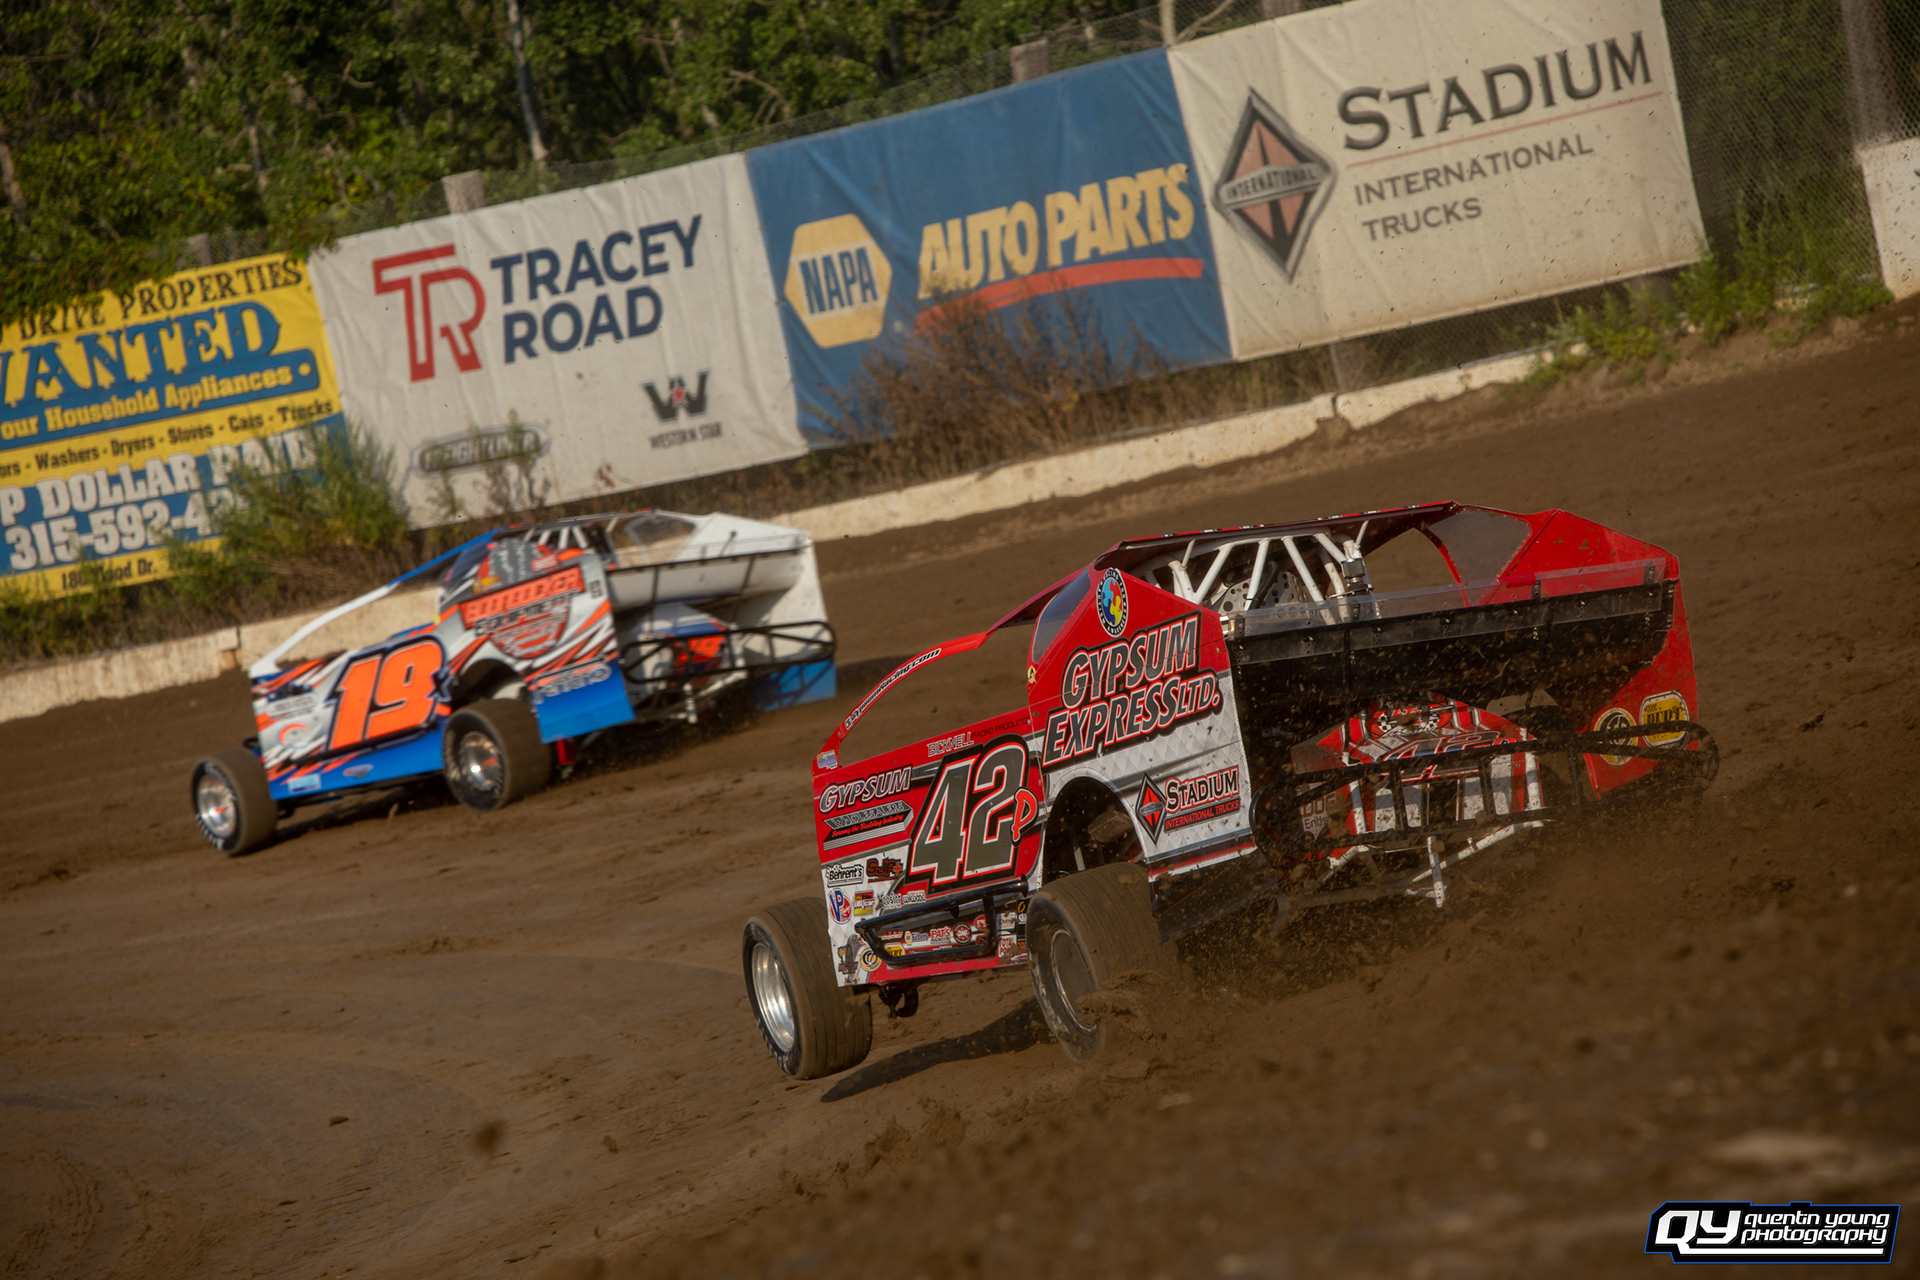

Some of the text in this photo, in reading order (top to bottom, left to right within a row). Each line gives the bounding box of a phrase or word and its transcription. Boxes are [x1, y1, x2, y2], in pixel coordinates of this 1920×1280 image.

[1337, 31, 1654, 151] STADIUM
[1226, 167, 1317, 199] INTERNATIONAL
[1353, 134, 1595, 207] INTERNATIONAL
[918, 163, 1196, 298] AUTO PARTS
[1362, 197, 1483, 243] TRUCKS
[490, 214, 702, 304] TRACEY
[799, 246, 879, 315] NAPA
[20, 258, 302, 341] DRIVE PROPERTIES
[502, 285, 664, 364] ROAD
[46, 387, 159, 431] Household
[166, 361, 293, 411] Appliances
[35, 447, 99, 472] Washers
[111, 436, 155, 458] Dryers
[168, 425, 214, 445] Stoves
[228, 412, 264, 432] Cars
[36, 453, 201, 520] DOLLAR
[329, 638, 448, 752] 19
[1062, 614, 1199, 708] GYPSUM
[927, 716, 1031, 757] BICKNELL RACING PRODUCTS
[819, 766, 912, 813] GYPSUM
[832, 802, 905, 828] WHOLESALERS
[909, 744, 1028, 886] 42
[1165, 800, 1240, 830] INTERNATIONAL TRUCKS
[1166, 769, 1239, 810] STADIUM
[829, 889, 844, 922] VP
